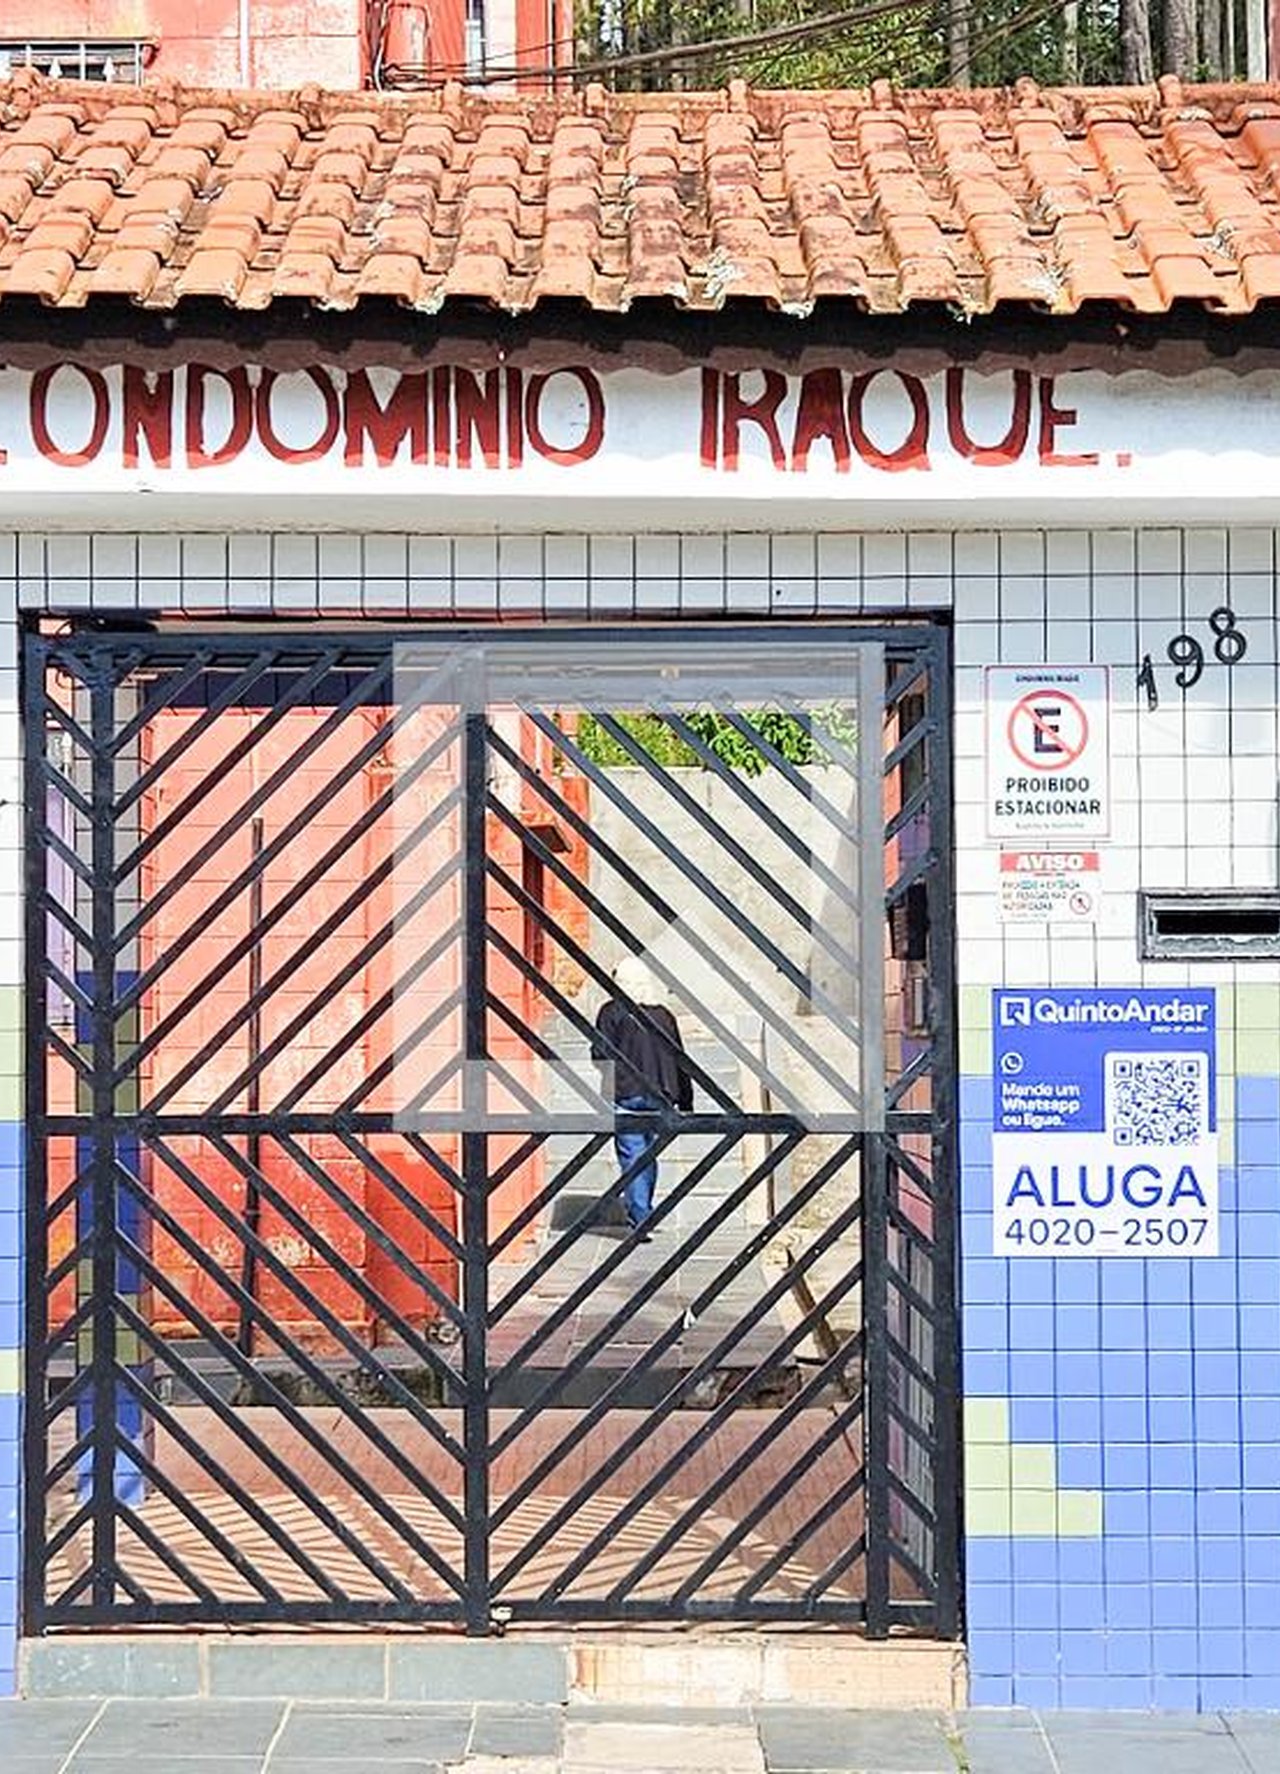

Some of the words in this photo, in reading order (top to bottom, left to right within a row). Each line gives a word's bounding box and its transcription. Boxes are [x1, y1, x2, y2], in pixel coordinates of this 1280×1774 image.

[1137, 606, 1247, 711] 198
[1006, 777, 1091, 793] PROIBIDO
[995, 799, 1101, 816] ESTACIONAR
[1016, 853, 1084, 871] AVISO
[1034, 998, 1209, 1024] QuintoAndar
[1055, 1085, 1081, 1097] um
[1002, 1115, 1022, 1126] ou
[1005, 1164, 1208, 1208] ALUGA
[1005, 1218, 1209, 1246] 4020-2507
